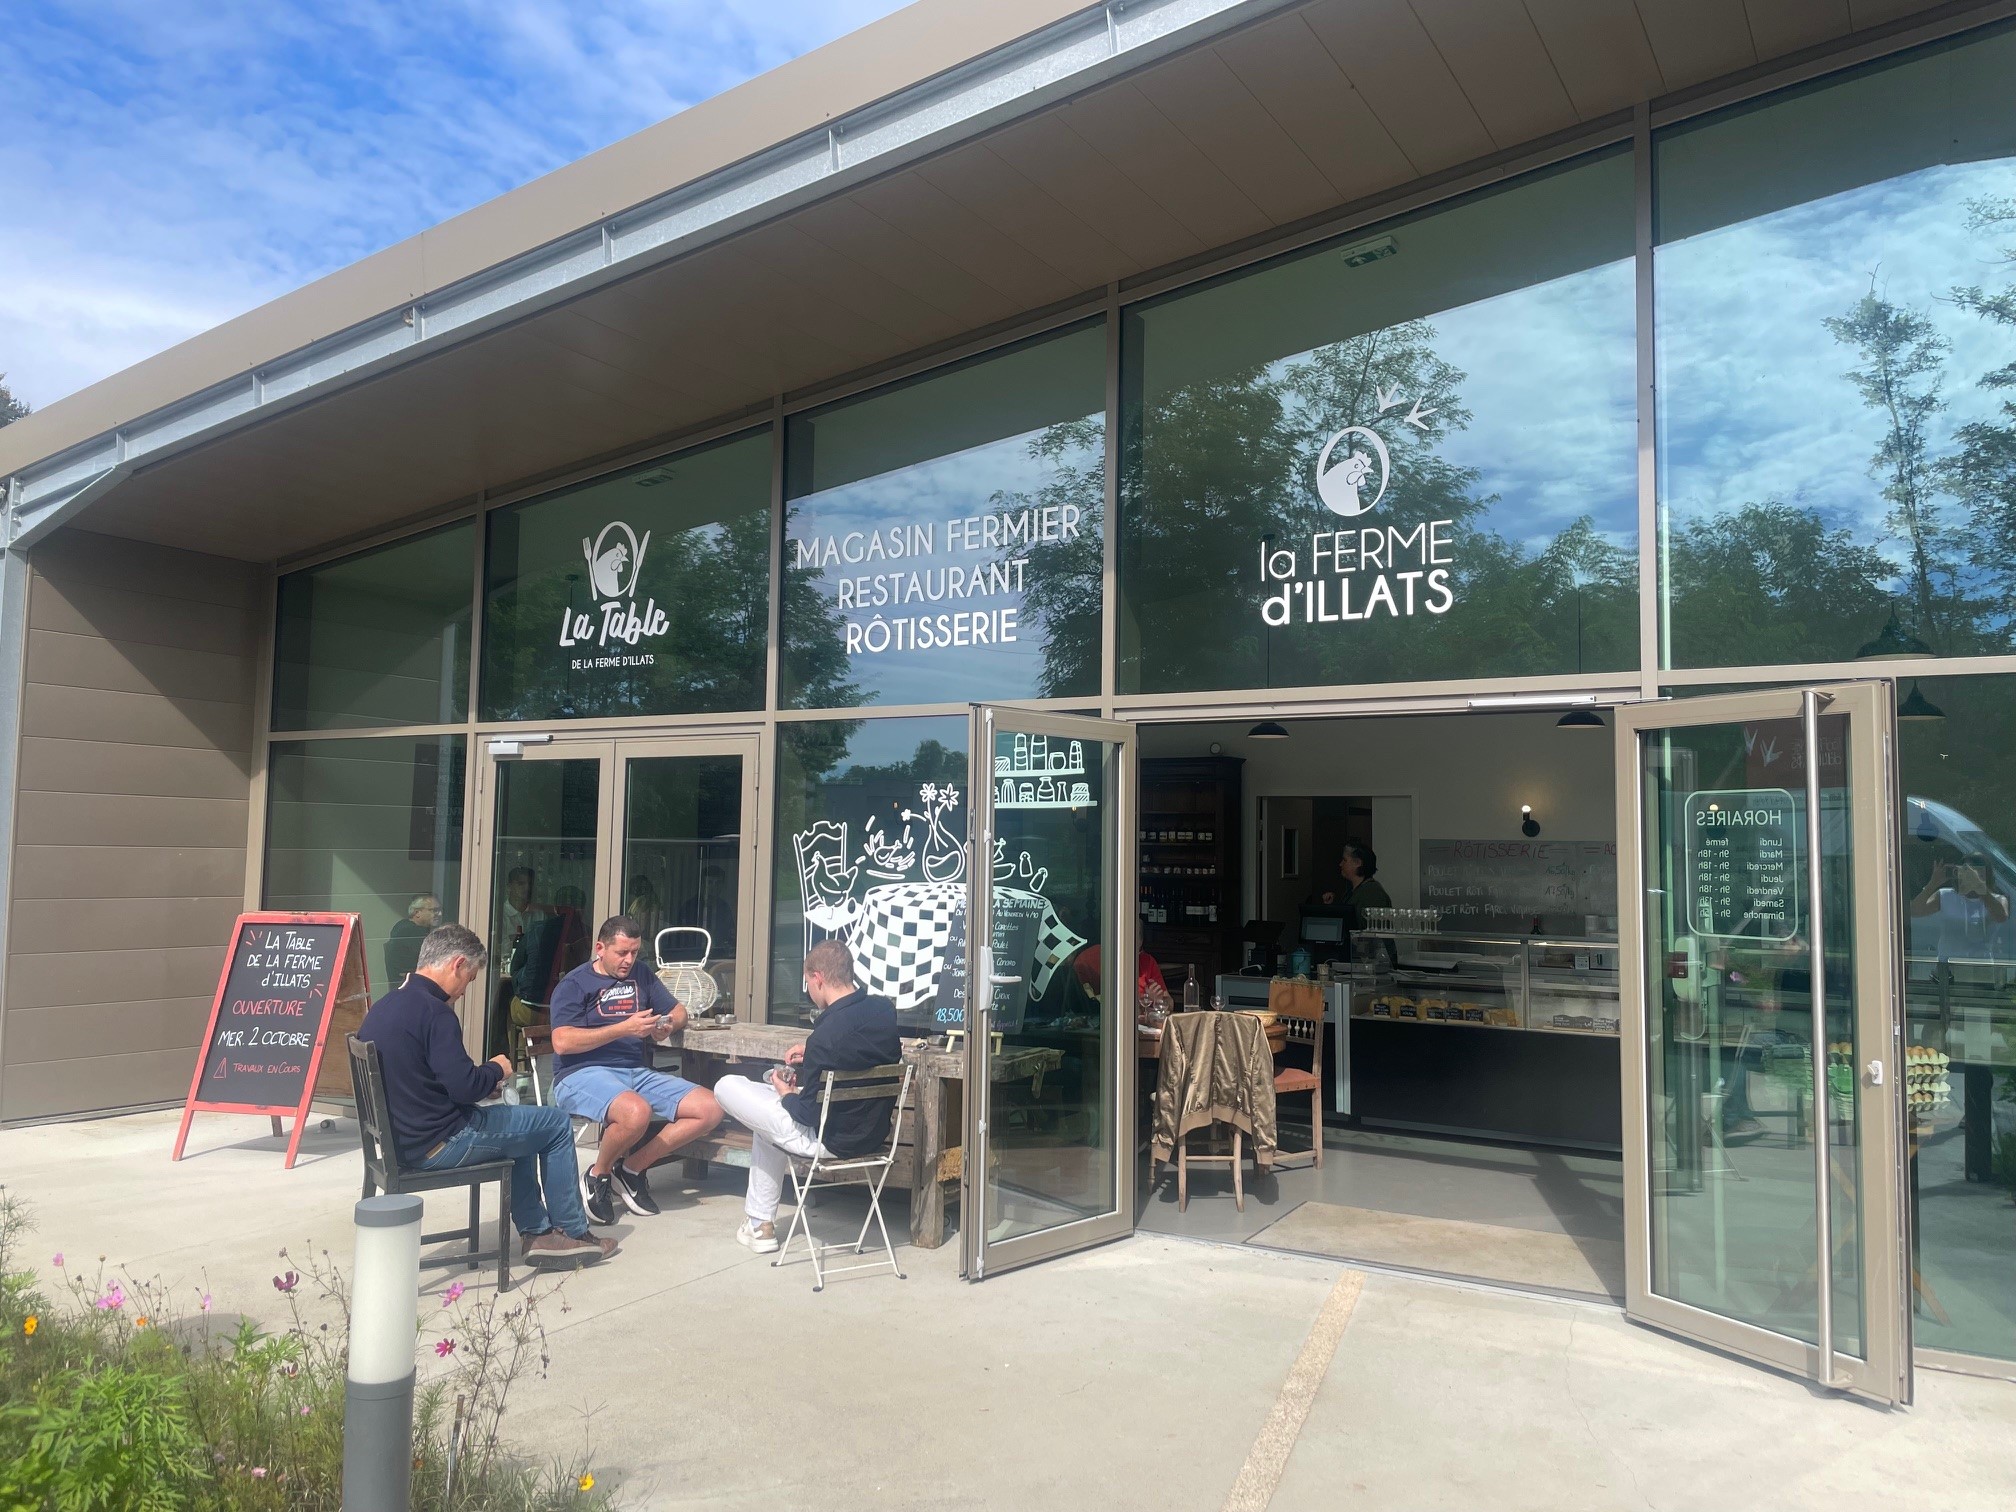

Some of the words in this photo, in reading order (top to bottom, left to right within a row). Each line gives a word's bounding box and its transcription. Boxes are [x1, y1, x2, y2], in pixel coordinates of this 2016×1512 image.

[797, 522, 934, 569] MAGASIN
[947, 504, 1080, 552] FERMIER
[1260, 541, 1296, 582] la
[1313, 519, 1453, 575] FERME
[838, 558, 1030, 609] RESTAURANT
[1261, 568, 1454, 626] d'ILLATS
[559, 606, 595, 647] La
[599, 597, 670, 647] Table
[846, 608, 1018, 655] RÔTISSERIE
[572, 659, 581, 669] DE
[583, 659, 593, 669] LA
[595, 656, 620, 668] FERME
[622, 654, 654, 666] D'ILLATS
[1428, 885, 1463, 896] POULET
[265, 931, 280, 950] LA
[246, 954, 262, 967] DE
[266, 954, 280, 968] LA
[284, 954, 324, 970] FERME
[261, 970, 311, 989] d'ILLATS
[232, 998, 306, 1016] OUVERTURE
[217, 1030, 245, 1047] MER.
[248, 1026, 260, 1046] 2
[261, 1030, 311, 1048] OCTOBRE
[233, 1062, 264, 1074] TRAVAUX
